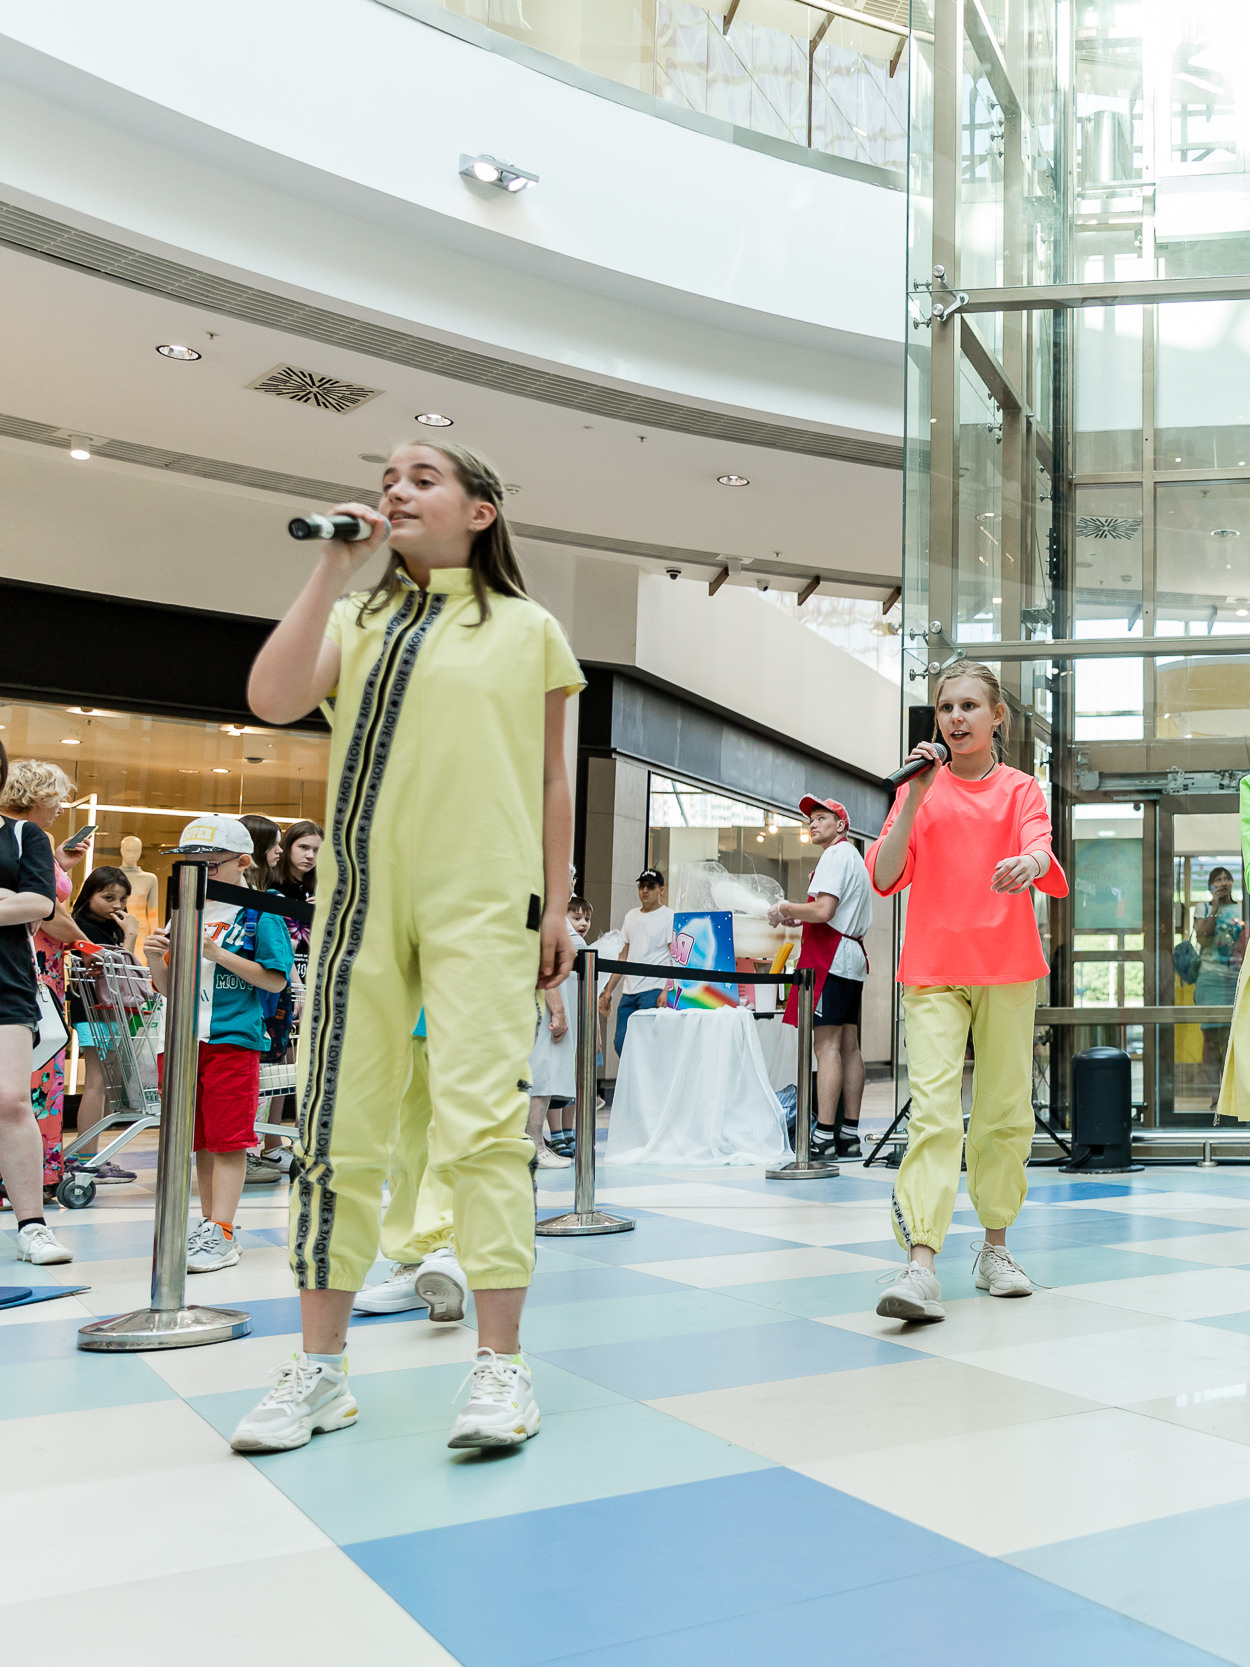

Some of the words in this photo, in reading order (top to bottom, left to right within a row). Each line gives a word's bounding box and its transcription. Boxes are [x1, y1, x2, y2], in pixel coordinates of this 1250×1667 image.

[385, 616, 403, 637] LOVE
[424, 604, 440, 625] LOVE
[405, 632, 424, 656] LOVE
[393, 669, 410, 698] LOVE
[360, 691, 373, 719] LOVE
[381, 710, 398, 738] LOVE
[348, 735, 363, 762] LOVE
[372, 752, 386, 780] LOVE
[340, 775, 355, 803] LOVE
[361, 794, 377, 822] LOVE
[333, 820, 343, 847] LOVE
[357, 837, 368, 865] LOVE
[338, 860, 348, 886] LOVE
[358, 877, 370, 905] LOVE
[328, 900, 343, 926] LOVE
[350, 919, 363, 946] LOVE
[318, 940, 332, 967] LOVE
[216, 974, 254, 991] MOV
[336, 958, 352, 986] LOVE
[313, 985, 322, 1012] LOVE
[334, 1003, 345, 1030] LOVE
[327, 1045, 340, 1072] LOVE
[321, 1089, 335, 1117] LOVE
[299, 1212, 309, 1238] LOVE
[894, 1207, 904, 1225] TIME
[316, 1230, 330, 1255] LOVE
